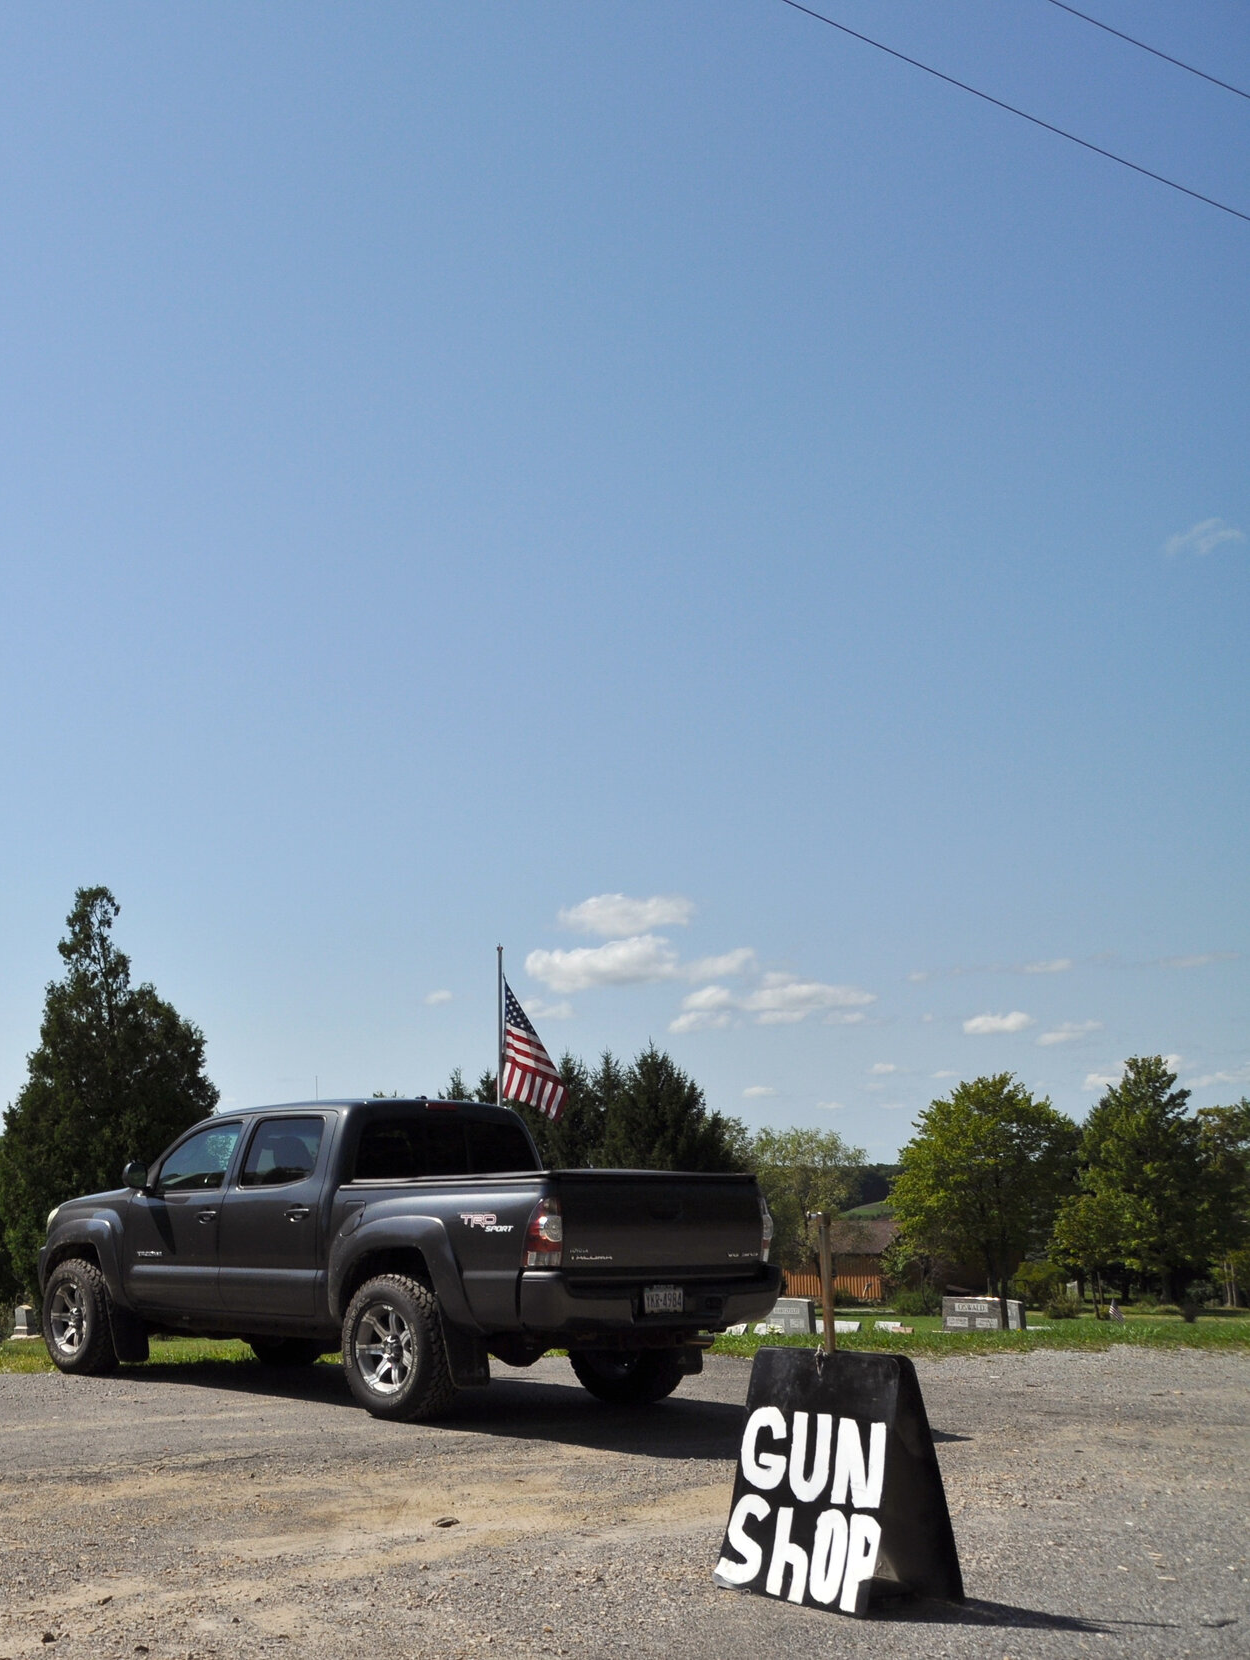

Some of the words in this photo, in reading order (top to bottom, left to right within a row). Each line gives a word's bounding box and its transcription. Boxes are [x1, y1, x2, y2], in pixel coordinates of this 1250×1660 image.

[460, 1214, 497, 1228] TRD
[484, 1225, 514, 1233] SPORT
[740, 1406, 887, 1509] GUN
